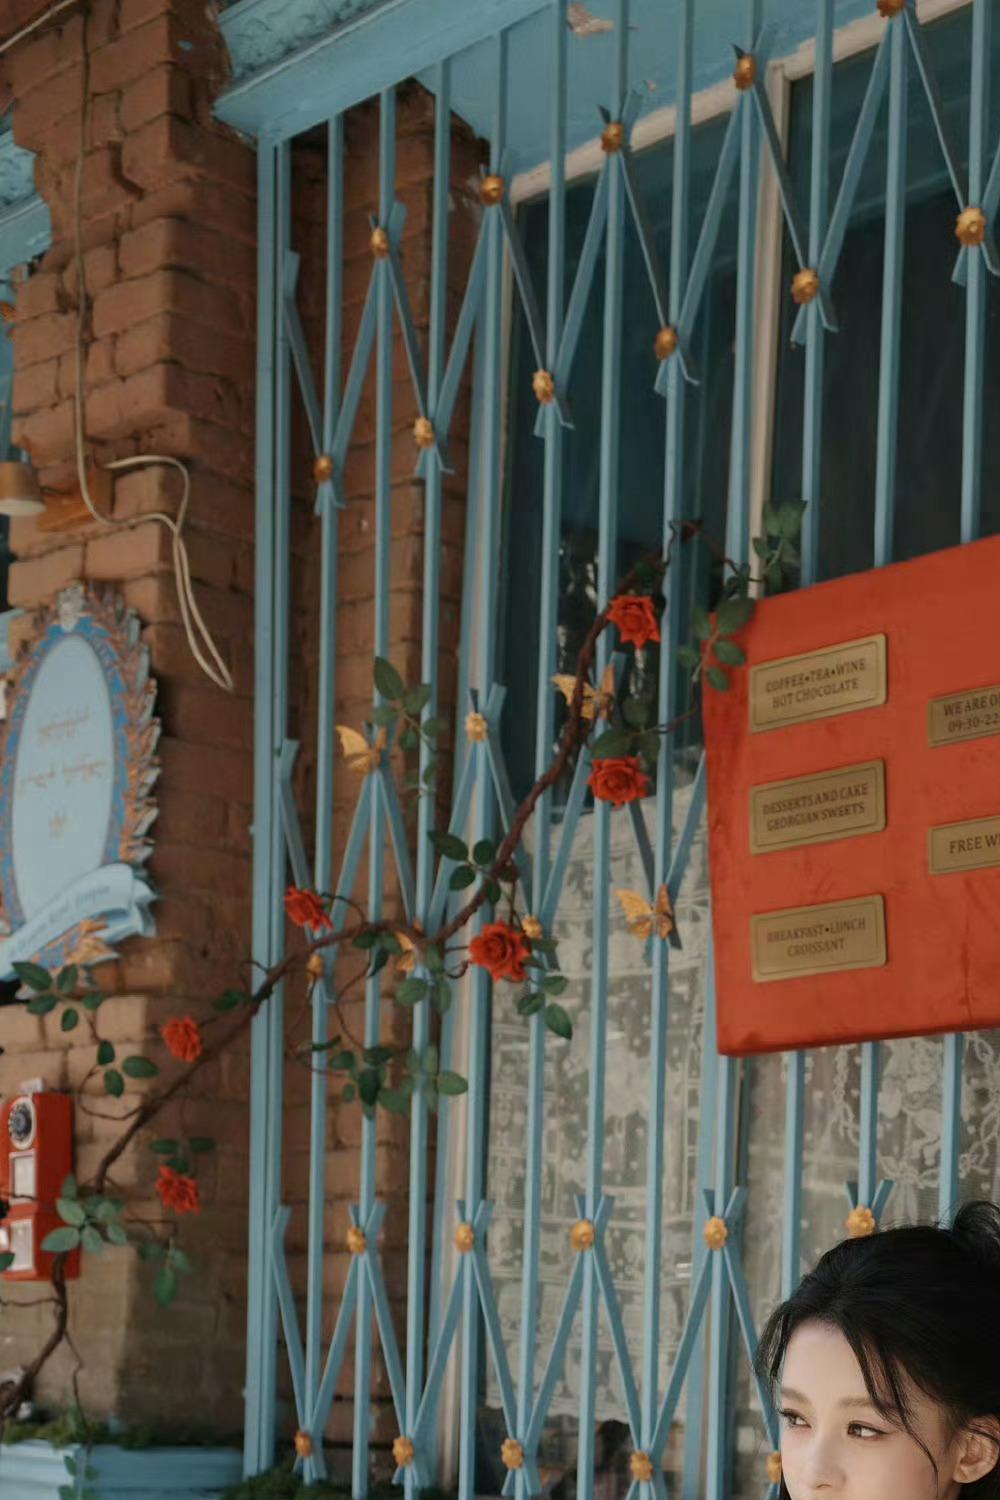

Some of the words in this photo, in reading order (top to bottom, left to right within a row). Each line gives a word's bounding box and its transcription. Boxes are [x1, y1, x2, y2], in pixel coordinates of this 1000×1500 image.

[772, 693, 794, 709] HOT
[795, 678, 859, 703] CHOCOLATE
[943, 701, 963, 717] WE
[964, 695, 988, 713] ARE
[762, 796, 813, 815] DESSERTS
[812, 790, 838, 806] AND
[839, 783, 868, 799] CAKE
[767, 811, 820, 832] GEORGIAN
[821, 801, 865, 820] SWEETS
[949, 835, 983, 854] FREE
[787, 938, 845, 957] CROISSANT
